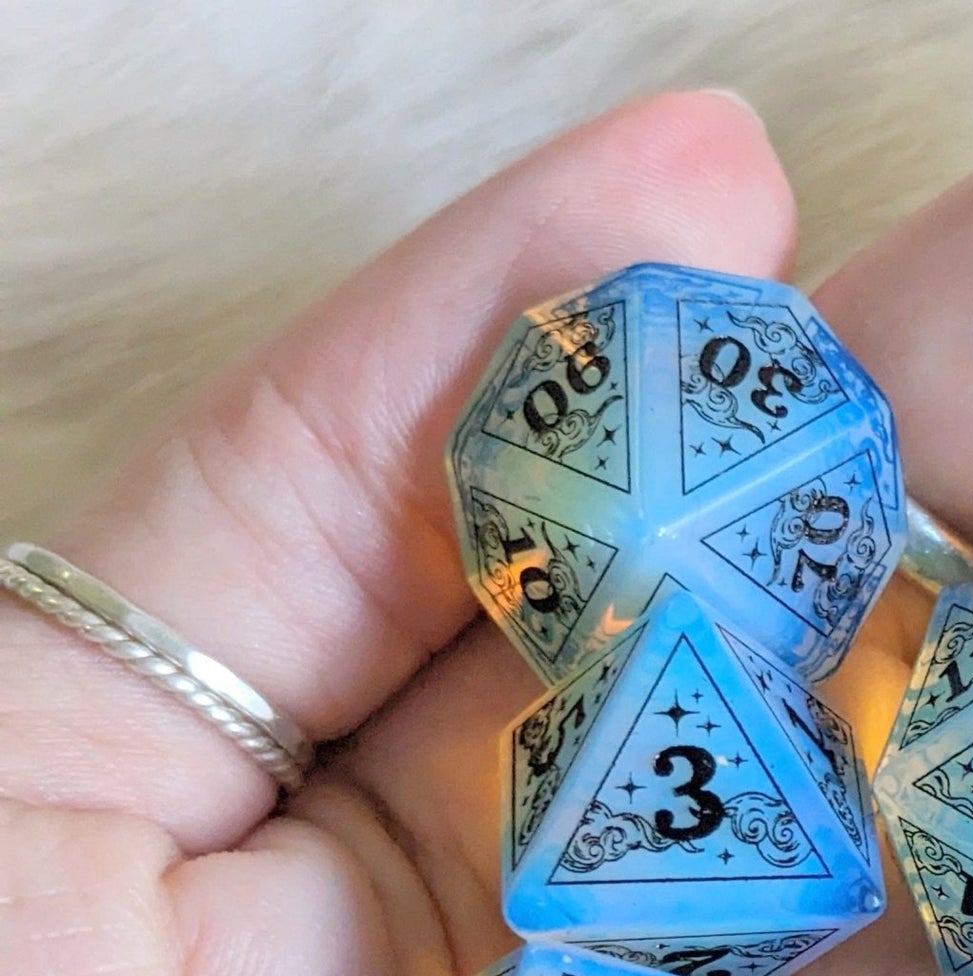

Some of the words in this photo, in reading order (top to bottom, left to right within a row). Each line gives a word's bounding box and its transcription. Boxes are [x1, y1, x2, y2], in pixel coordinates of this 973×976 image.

[699, 335, 802, 419] 30
[502, 521, 559, 614] 10
[791, 494, 852, 594] 70
[653, 744, 726, 842] 3
